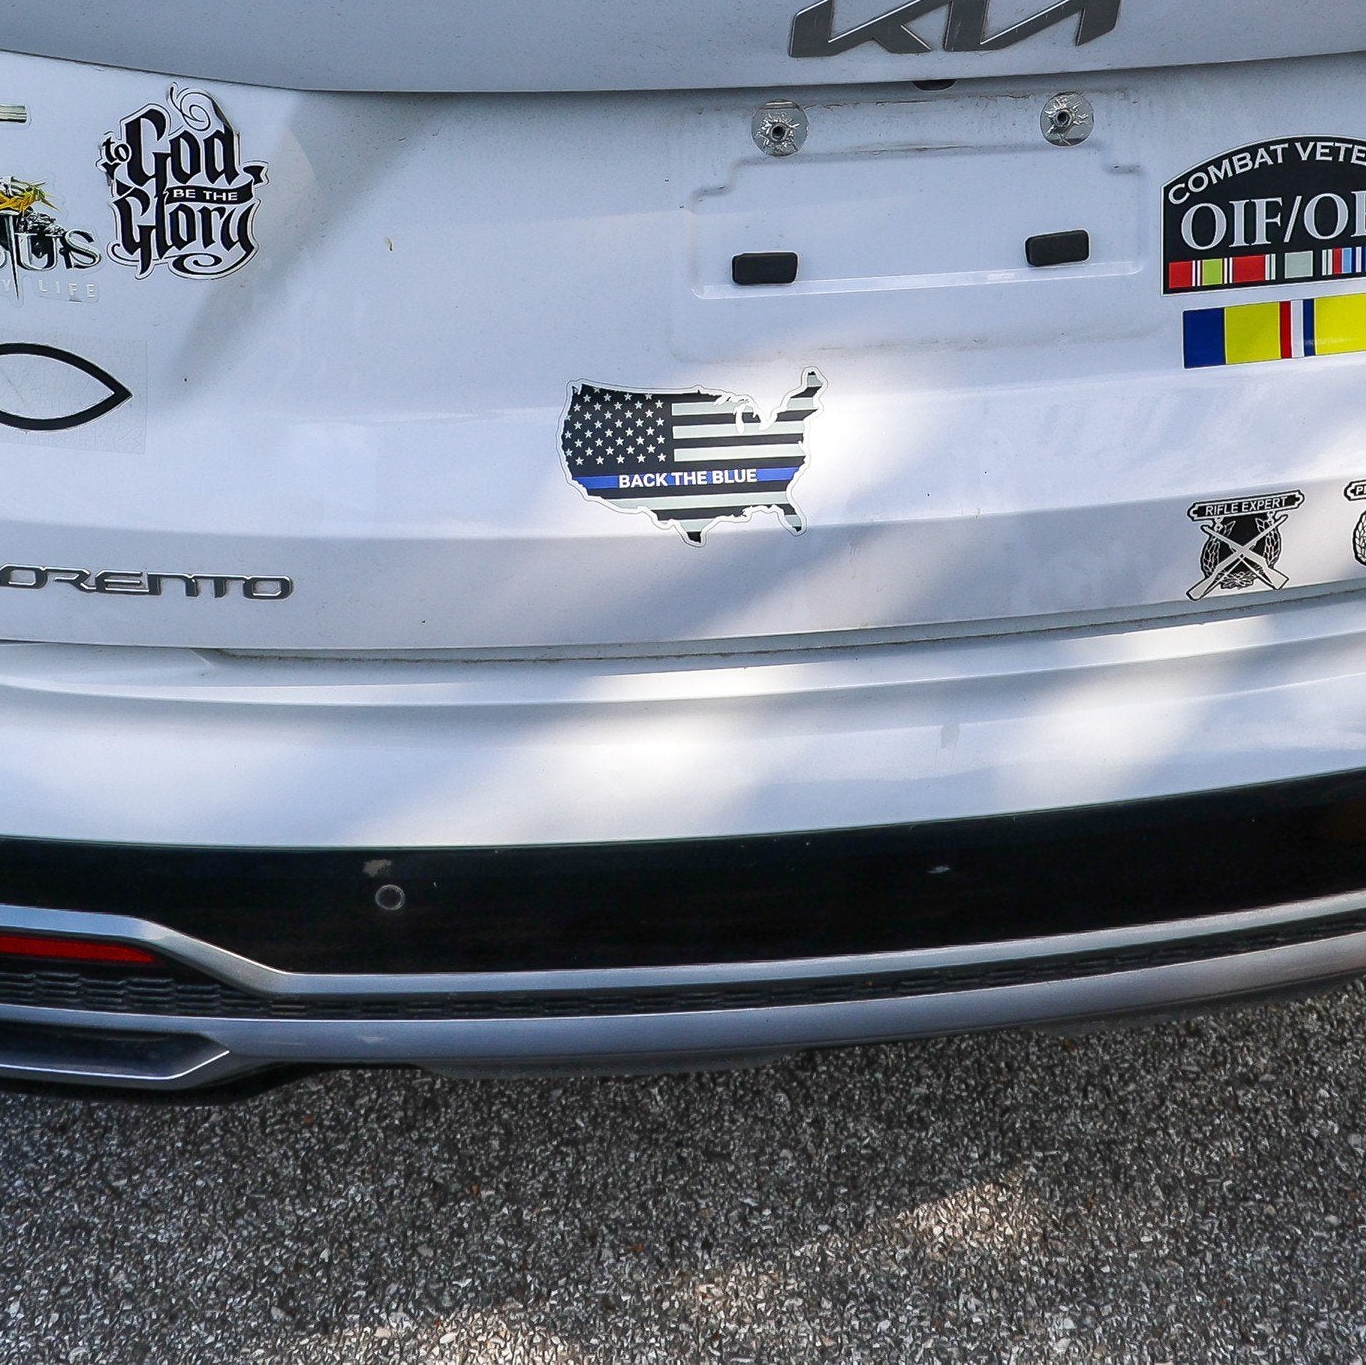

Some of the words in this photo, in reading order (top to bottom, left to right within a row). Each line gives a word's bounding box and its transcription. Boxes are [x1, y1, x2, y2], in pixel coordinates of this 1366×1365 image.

[125, 87, 240, 187] God
[102, 137, 130, 162] to
[1168, 143, 1288, 205] COMBAT
[173, 188, 196, 199] BE
[203, 190, 239, 201] THE
[111, 195, 257, 276] Glory
[39, 280, 97, 299] LIFE
[619, 472, 668, 488] BACK
[671, 471, 708, 486] THE
[712, 469, 757, 484] BLUE
[1205, 502, 1239, 516] RIFLE
[1241, 497, 1288, 512] EXPERT
